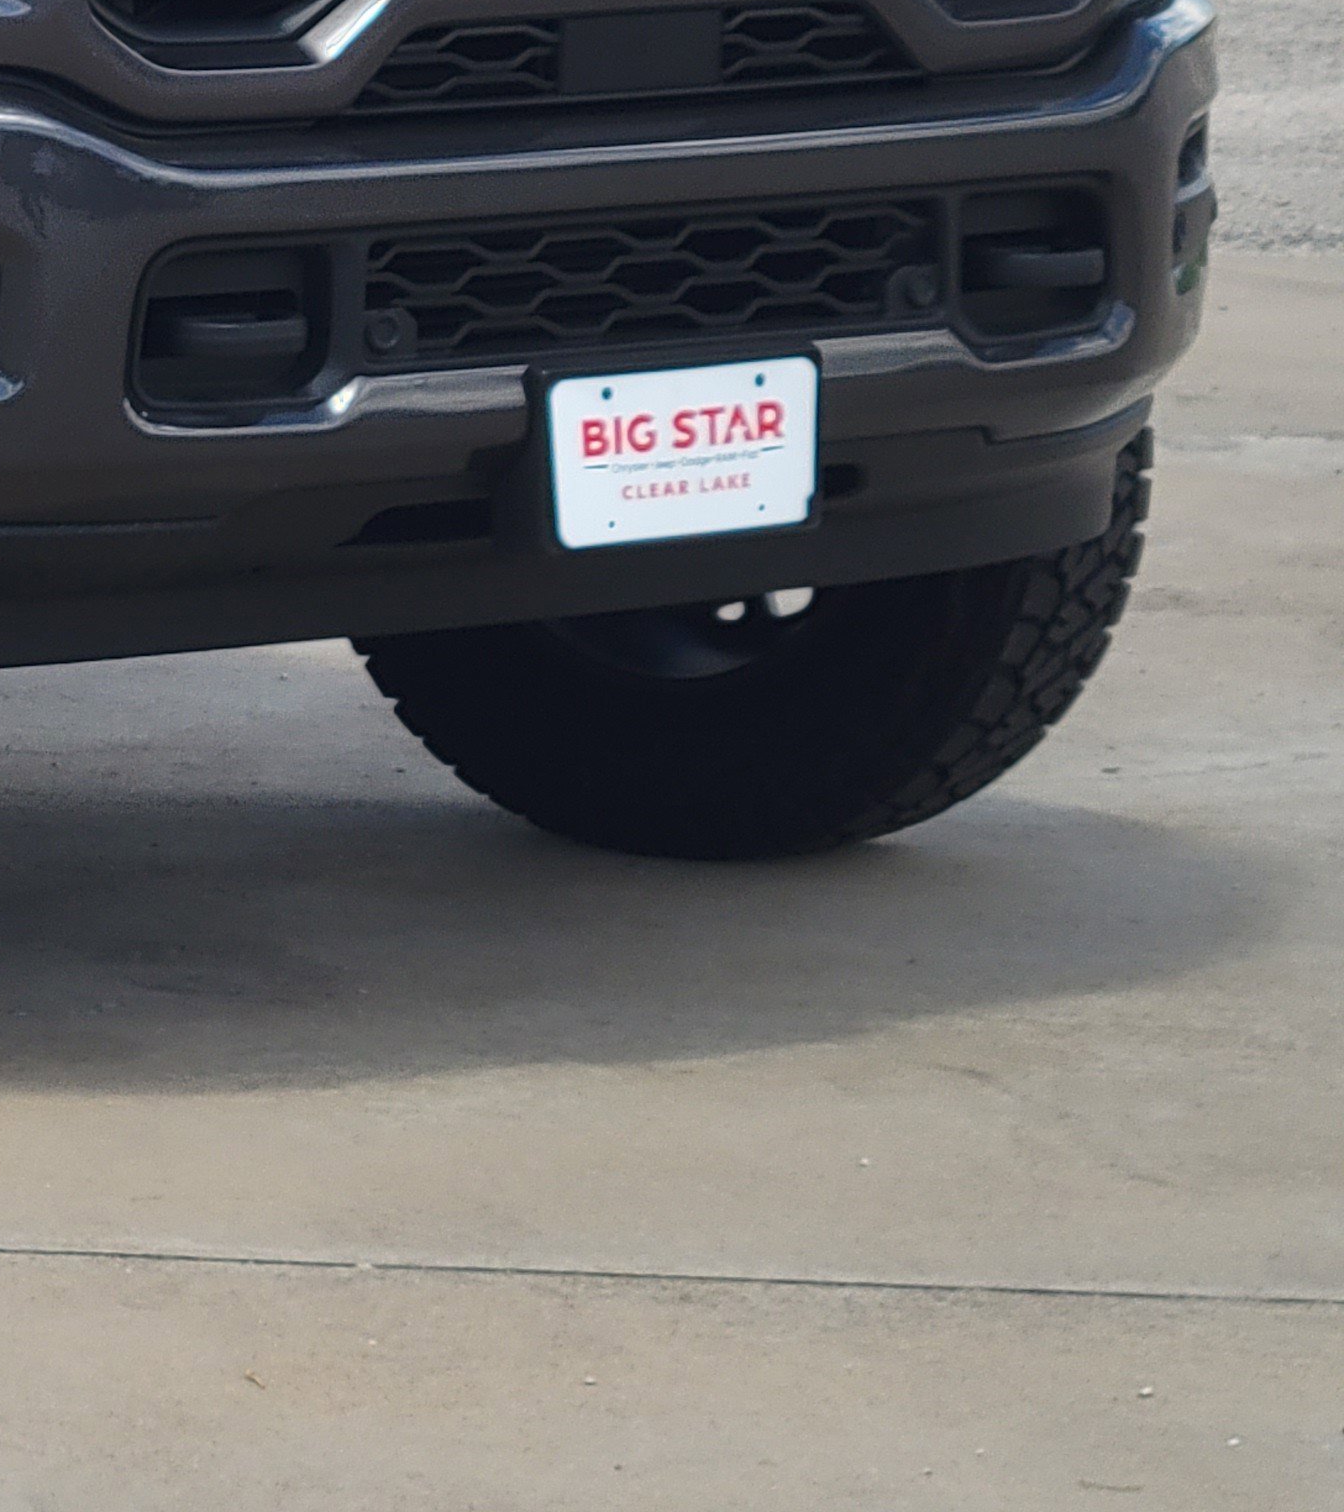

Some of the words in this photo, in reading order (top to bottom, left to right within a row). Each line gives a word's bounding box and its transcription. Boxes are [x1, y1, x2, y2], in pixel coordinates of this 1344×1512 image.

[582, 414, 657, 458] BIG
[672, 401, 784, 448] STAR
[622, 480, 689, 500] CLEAR
[699, 474, 752, 494] LAKE
